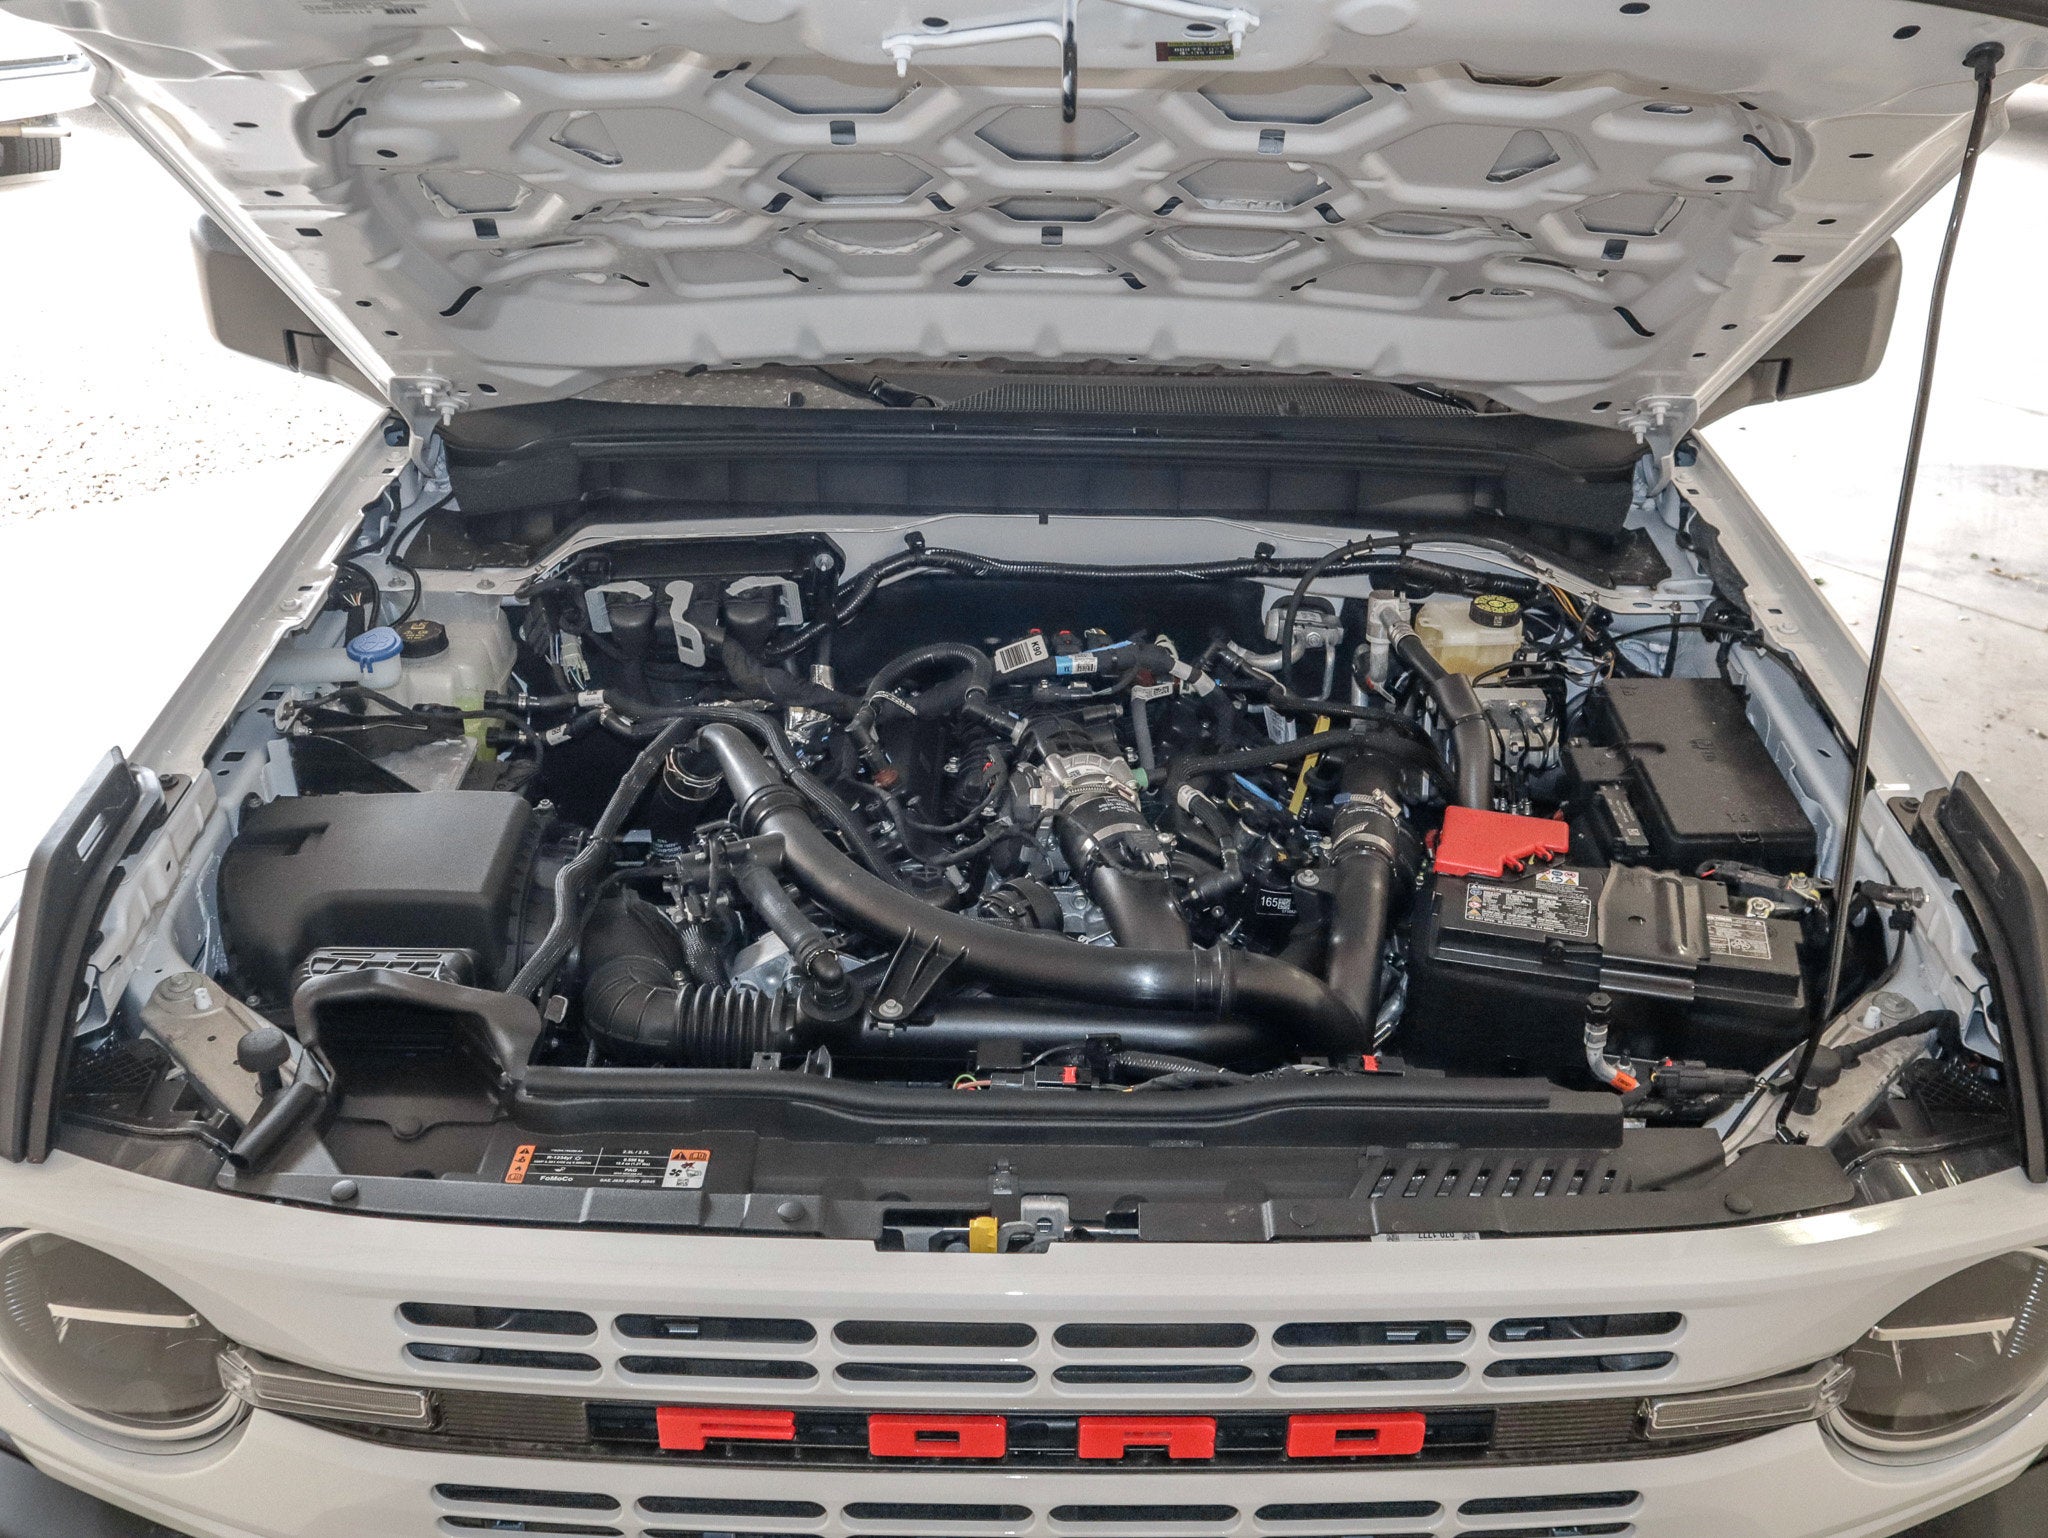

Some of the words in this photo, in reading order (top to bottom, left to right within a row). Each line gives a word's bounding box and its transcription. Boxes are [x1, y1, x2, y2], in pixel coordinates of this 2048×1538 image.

[1031, 641, 1042, 656] K90
[1261, 895, 1278, 907] 165
[656, 1407, 1426, 1459] FORD
